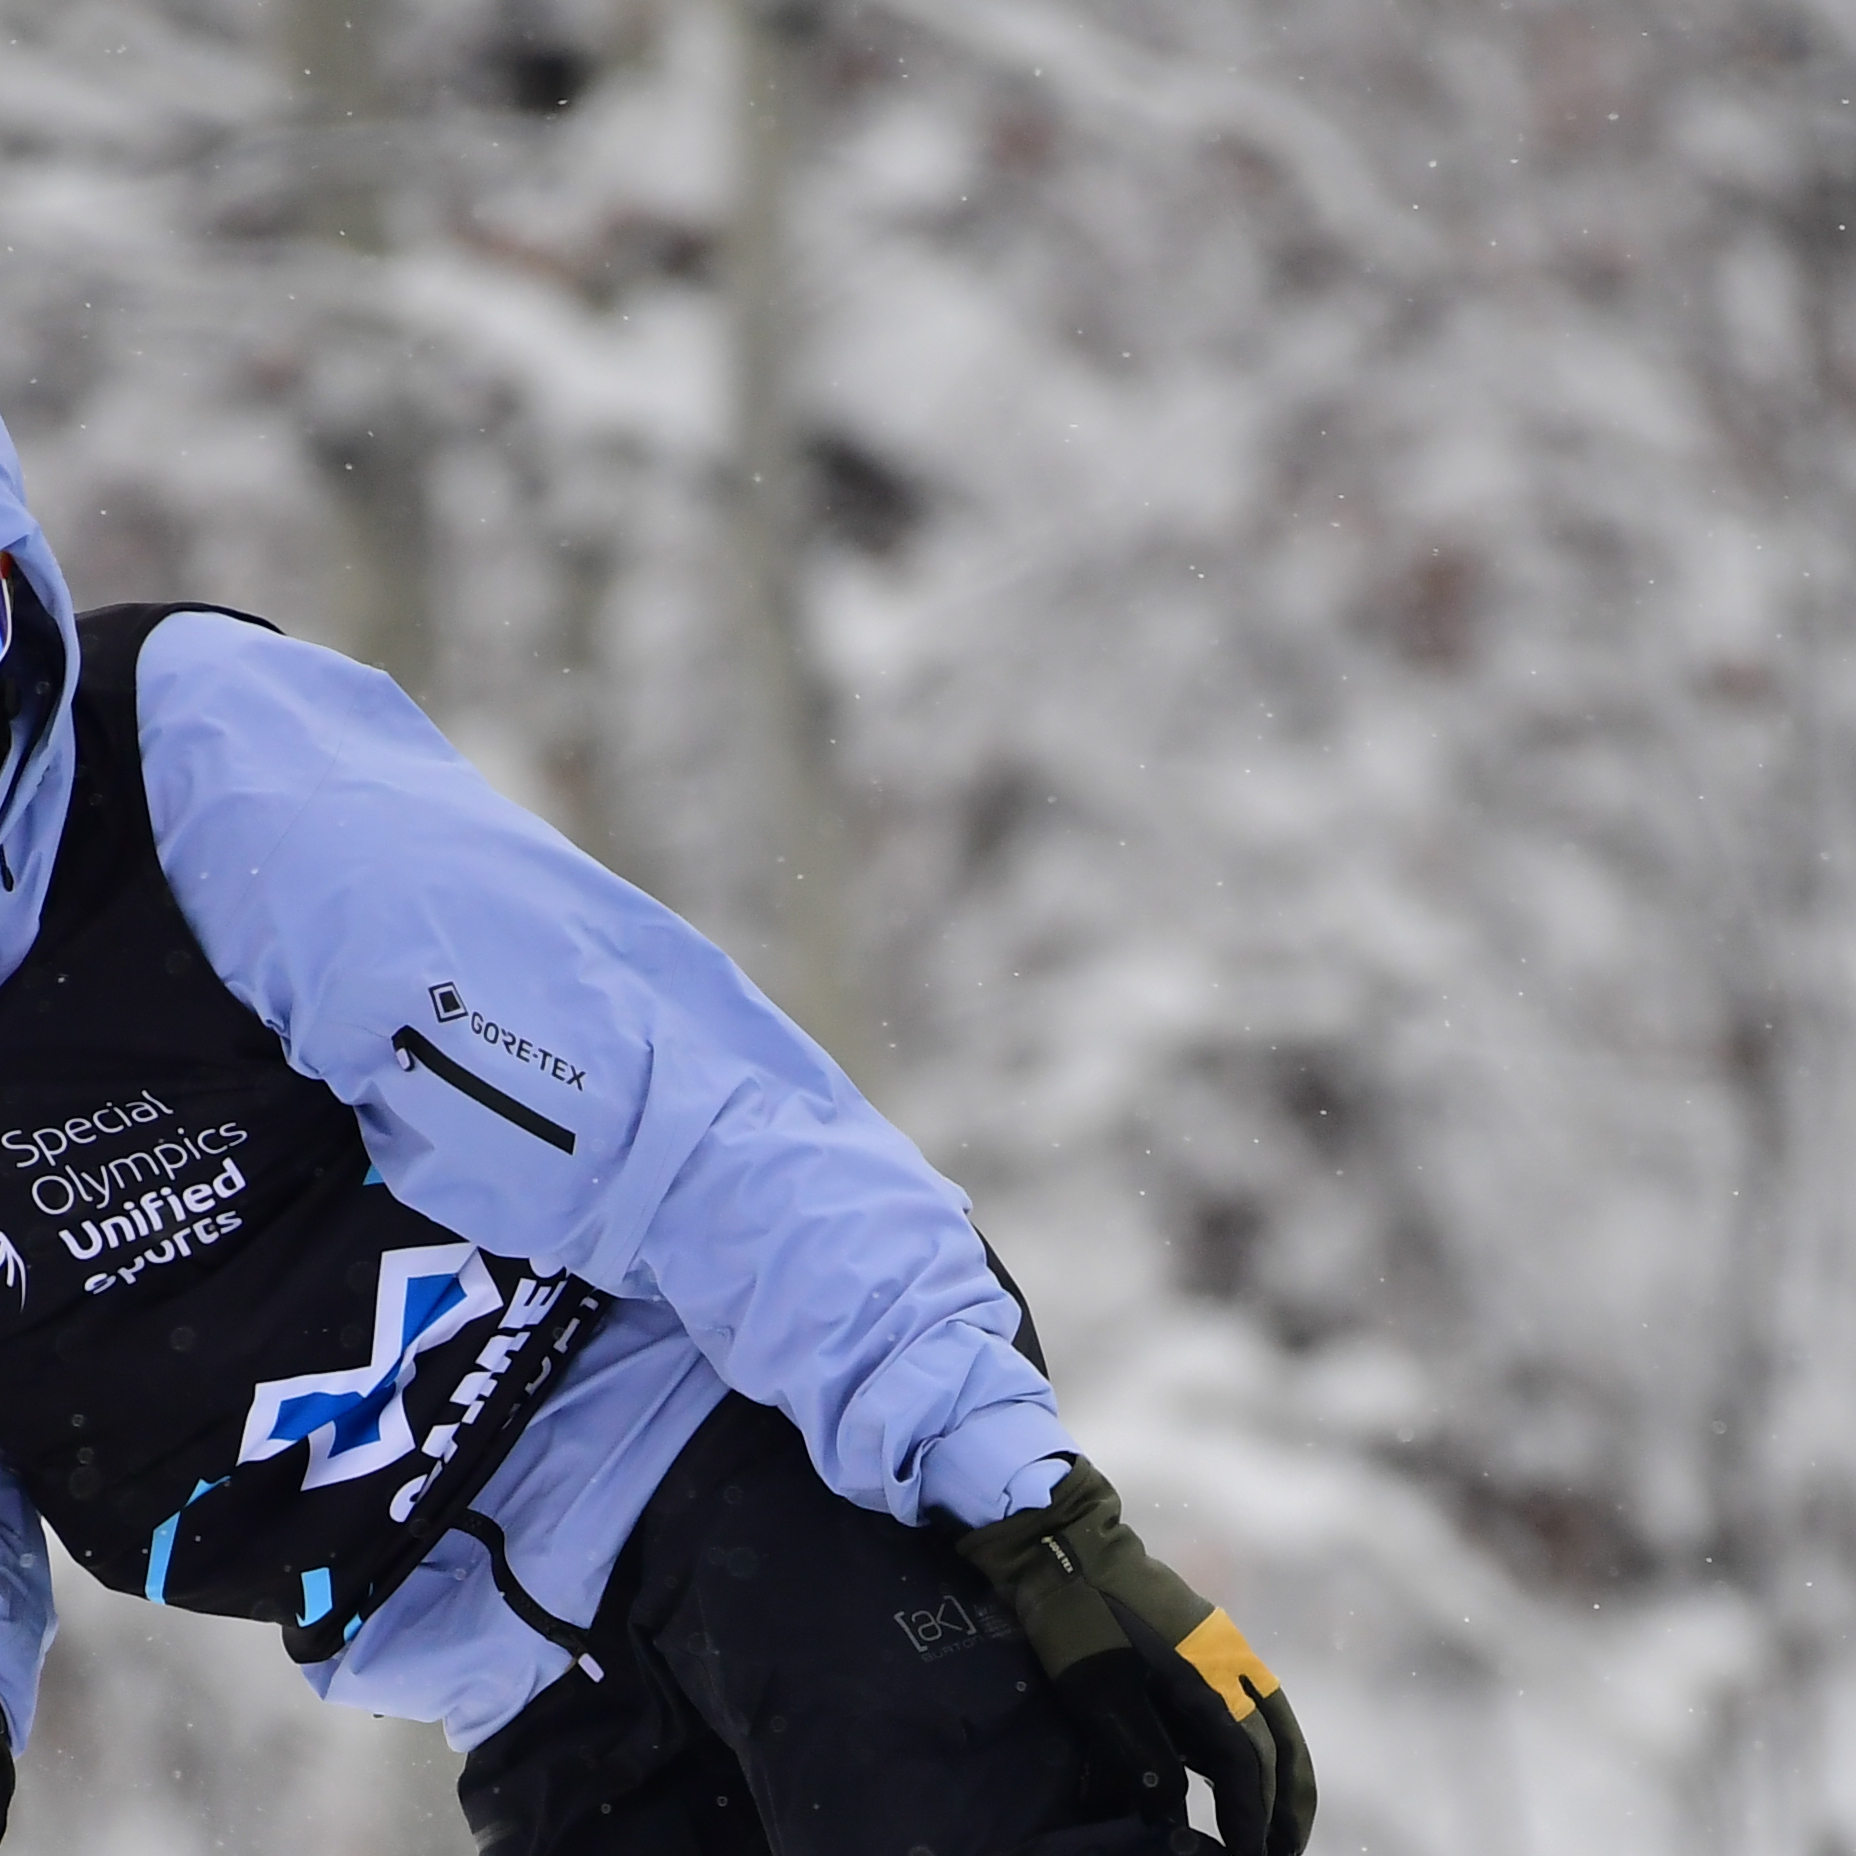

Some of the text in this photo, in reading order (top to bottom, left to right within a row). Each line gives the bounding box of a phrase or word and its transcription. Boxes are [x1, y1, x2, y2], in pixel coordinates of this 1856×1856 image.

[470, 1011, 587, 1092] GORE-TEX
[1, 1089, 174, 1169] Special
[31, 1121, 248, 1215] Olympics
[58, 1157, 247, 1260] Unified
